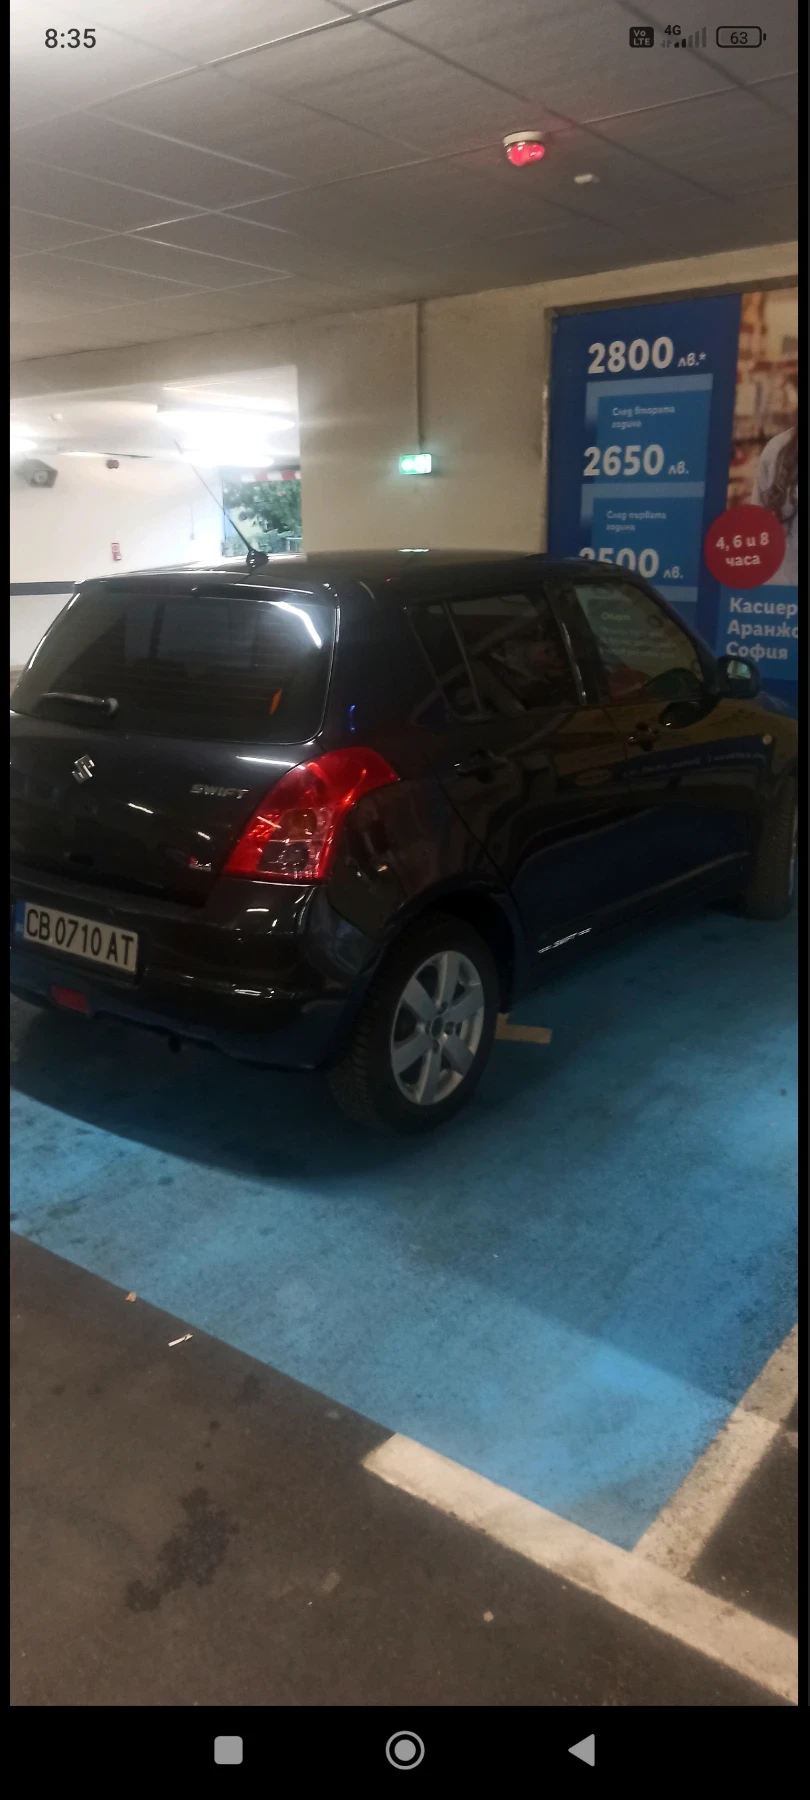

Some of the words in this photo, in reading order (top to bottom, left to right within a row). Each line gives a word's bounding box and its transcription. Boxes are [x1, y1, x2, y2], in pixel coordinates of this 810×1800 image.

[587, 336, 674, 374] 2800
[612, 407, 633, 418] След
[634, 405, 676, 415] втората
[611, 420, 642, 430] година
[583, 444, 665, 477] 2650
[667, 460, 690, 475] лв.
[606, 510, 627, 521] След
[628, 510, 667, 520] първата
[606, 524, 636, 533] година
[715, 537, 731, 552] 4,
[732, 534, 743, 549] 6
[759, 532, 770, 546] 8
[725, 555, 761, 567] часа
[663, 565, 684, 579] лв.
[726, 641, 789, 662] София
[26, 908, 51, 941] CB
[55, 917, 102, 956] 0710
[106, 931, 134, 966] AT
